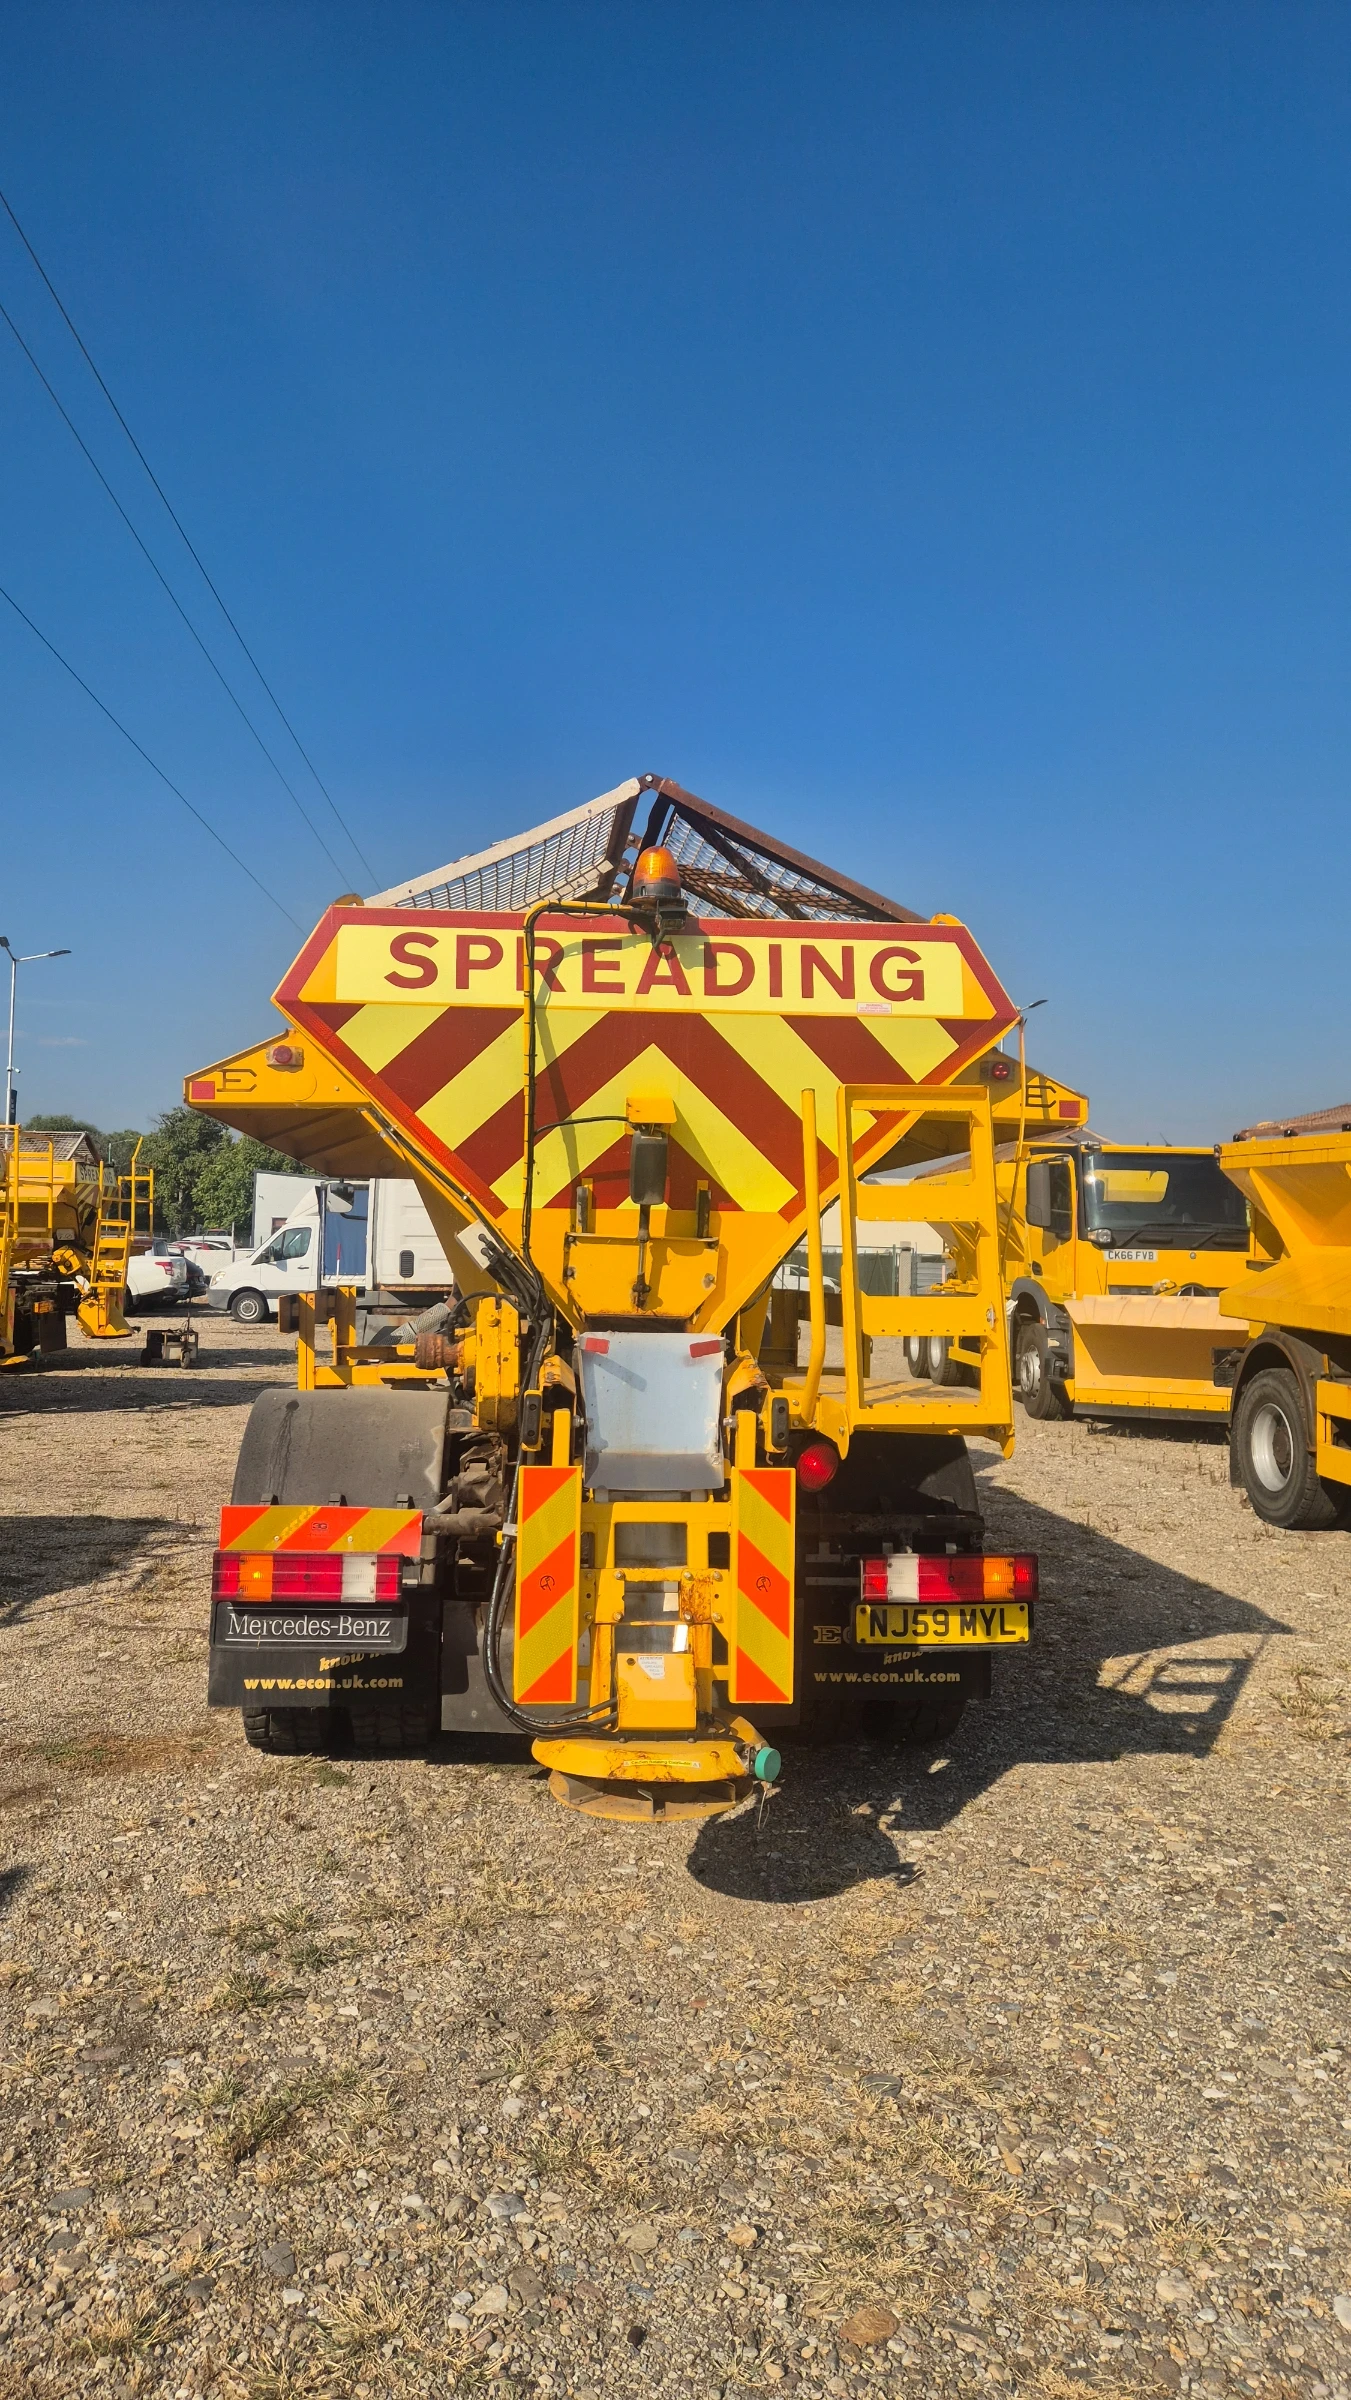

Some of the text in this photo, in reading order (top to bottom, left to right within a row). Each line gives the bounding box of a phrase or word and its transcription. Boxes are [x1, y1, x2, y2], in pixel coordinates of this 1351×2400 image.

[384, 931, 926, 1001] SPREADING
[1108, 1250, 1133, 1260] CK66
[227, 1613, 392, 1637] Mercedes-Benz
[869, 1607, 1017, 1638] NJ59 MYL
[319, 1652, 365, 1672] know
[243, 1675, 404, 1690] www.econ.uk.com
[813, 1669, 961, 1683] www.econ.uk.com
